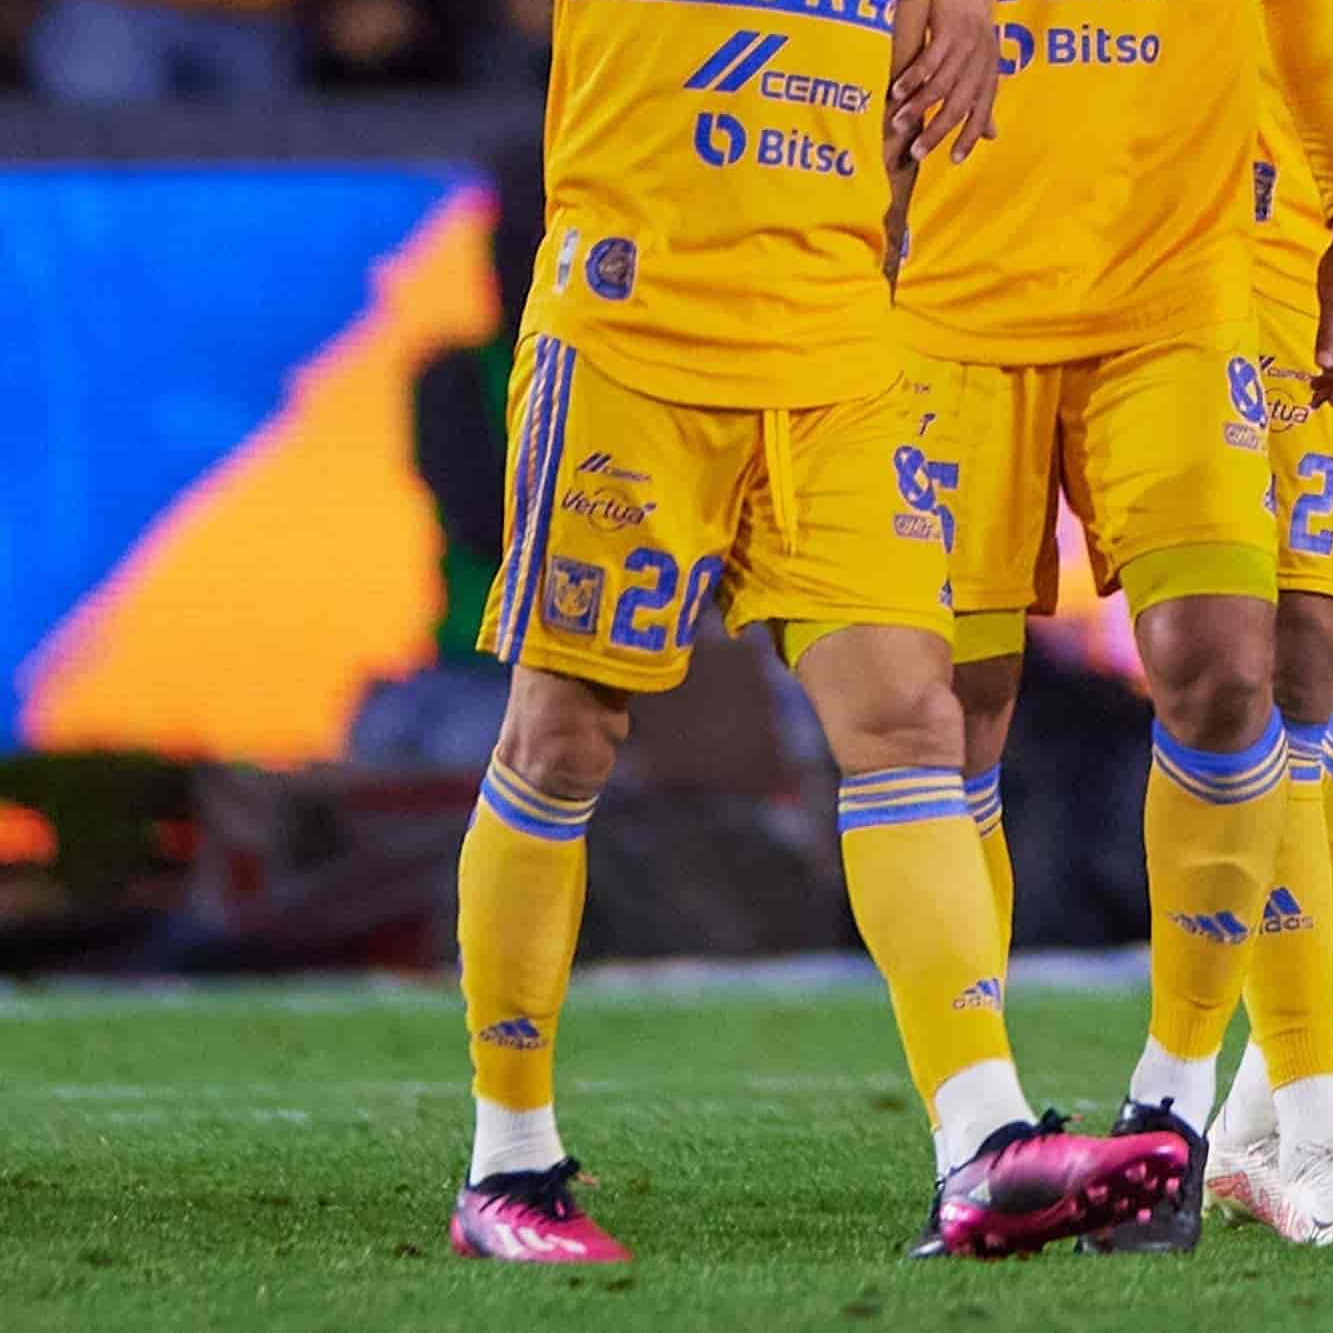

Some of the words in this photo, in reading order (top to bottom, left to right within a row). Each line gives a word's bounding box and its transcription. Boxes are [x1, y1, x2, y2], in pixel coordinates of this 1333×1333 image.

[1047, 24, 1160, 64] Bitso
[761, 70, 870, 113] CEMEX
[1270, 398, 1310, 425] tua
[561, 487, 646, 526] Vertua
